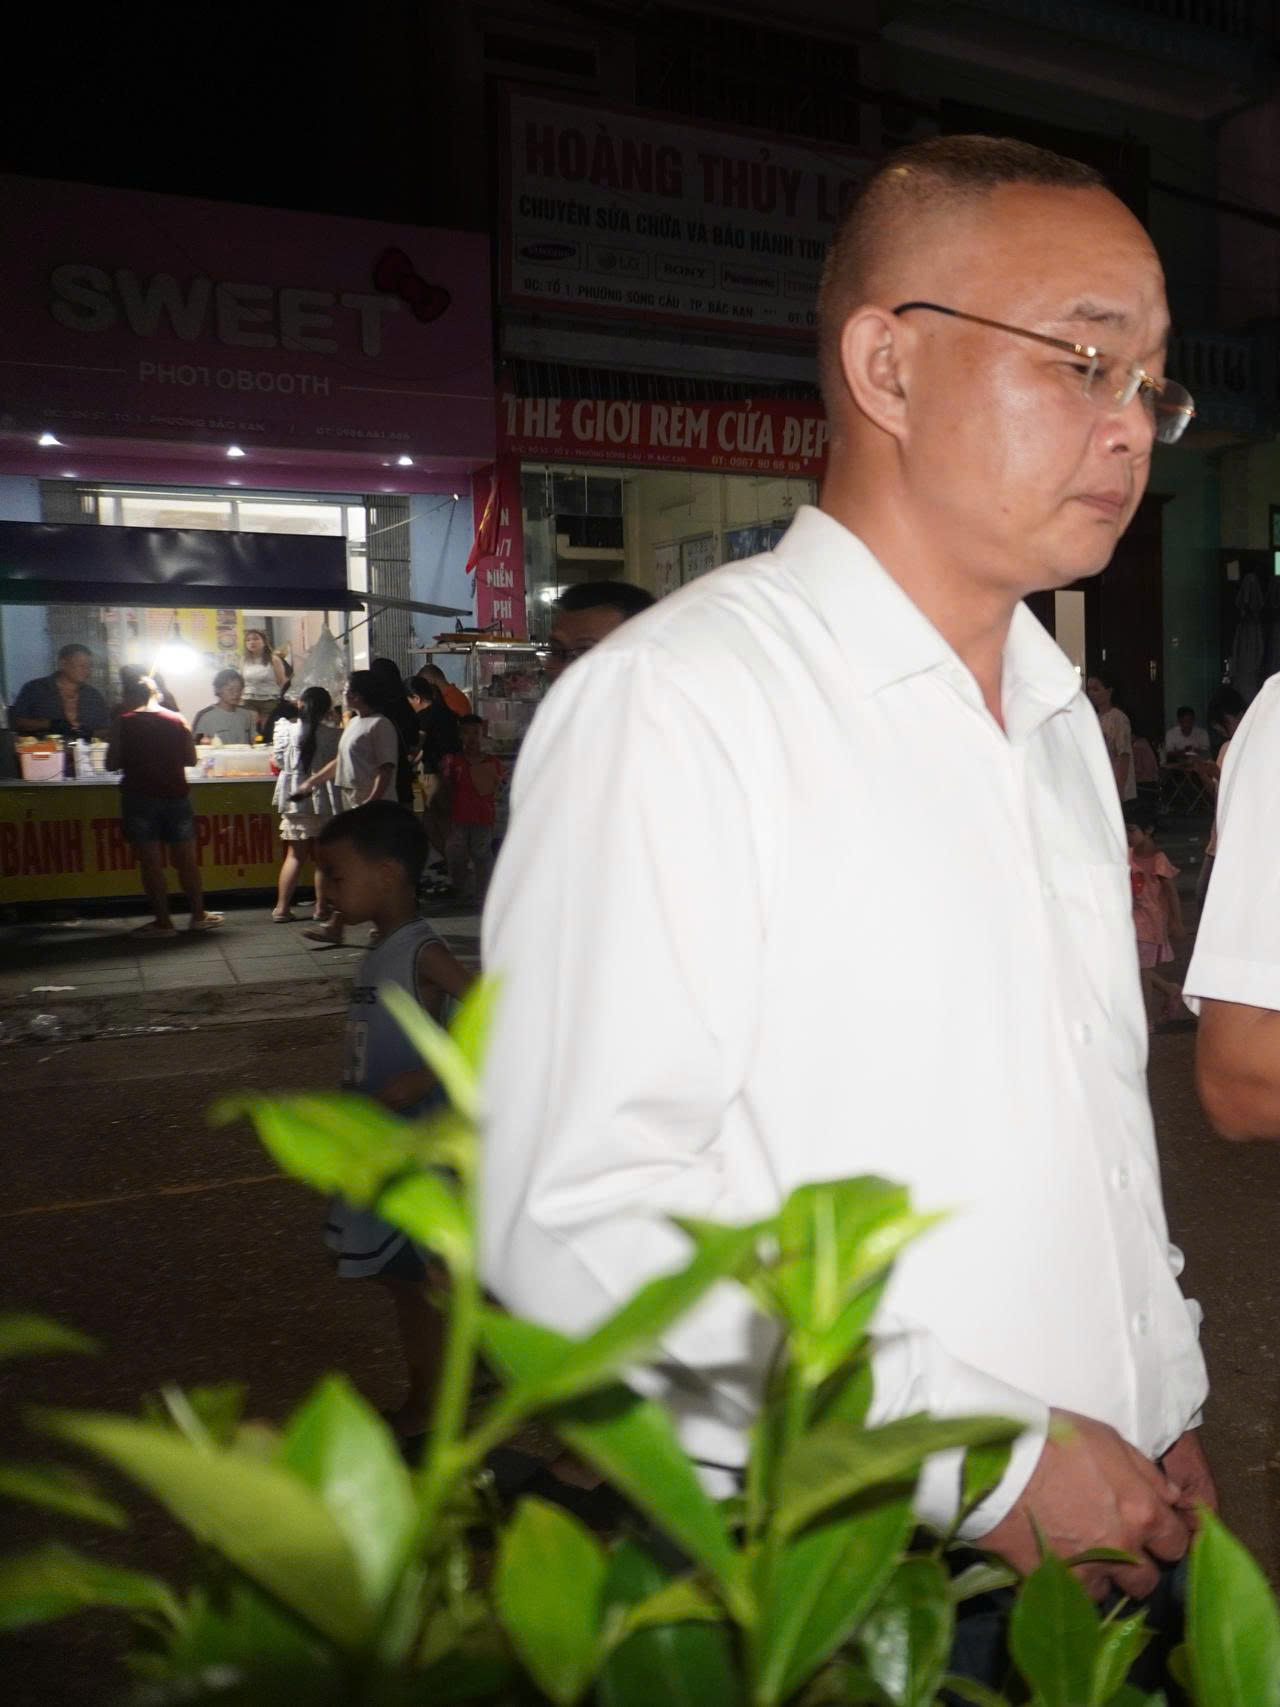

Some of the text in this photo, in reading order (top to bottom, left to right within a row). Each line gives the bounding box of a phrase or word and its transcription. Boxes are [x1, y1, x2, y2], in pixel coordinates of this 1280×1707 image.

[524, 120, 683, 197] HOÀNG
[519, 195, 590, 227] CHUYÊN
[595, 202, 631, 232] SỬA
[636, 211, 682, 240] CHỮA
[49, 263, 402, 359] SWEET
[138, 360, 331, 397] PHOTOBOOTH
[716, 398, 776, 455] CỬA
[493, 596, 512, 619] PHÍ
